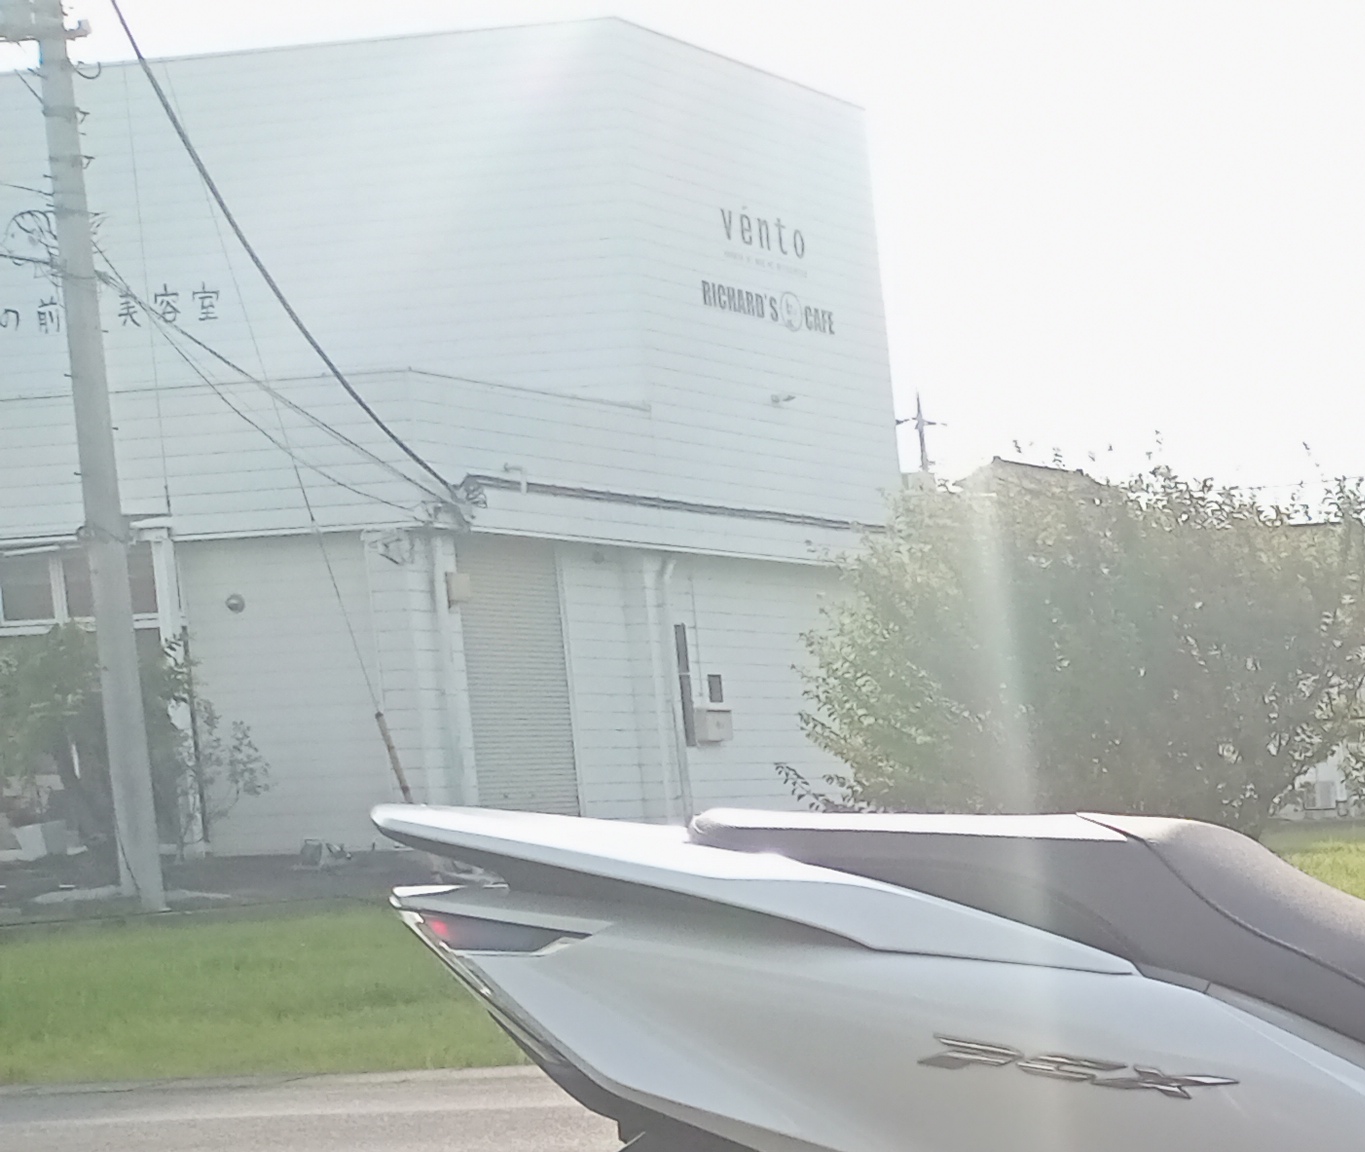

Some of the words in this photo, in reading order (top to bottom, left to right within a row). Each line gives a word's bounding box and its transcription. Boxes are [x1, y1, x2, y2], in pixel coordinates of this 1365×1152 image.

[0, 281, 220, 334] の前美容室
[701, 279, 779, 322] RICHARD'S
[804, 305, 835, 335] CAFE
